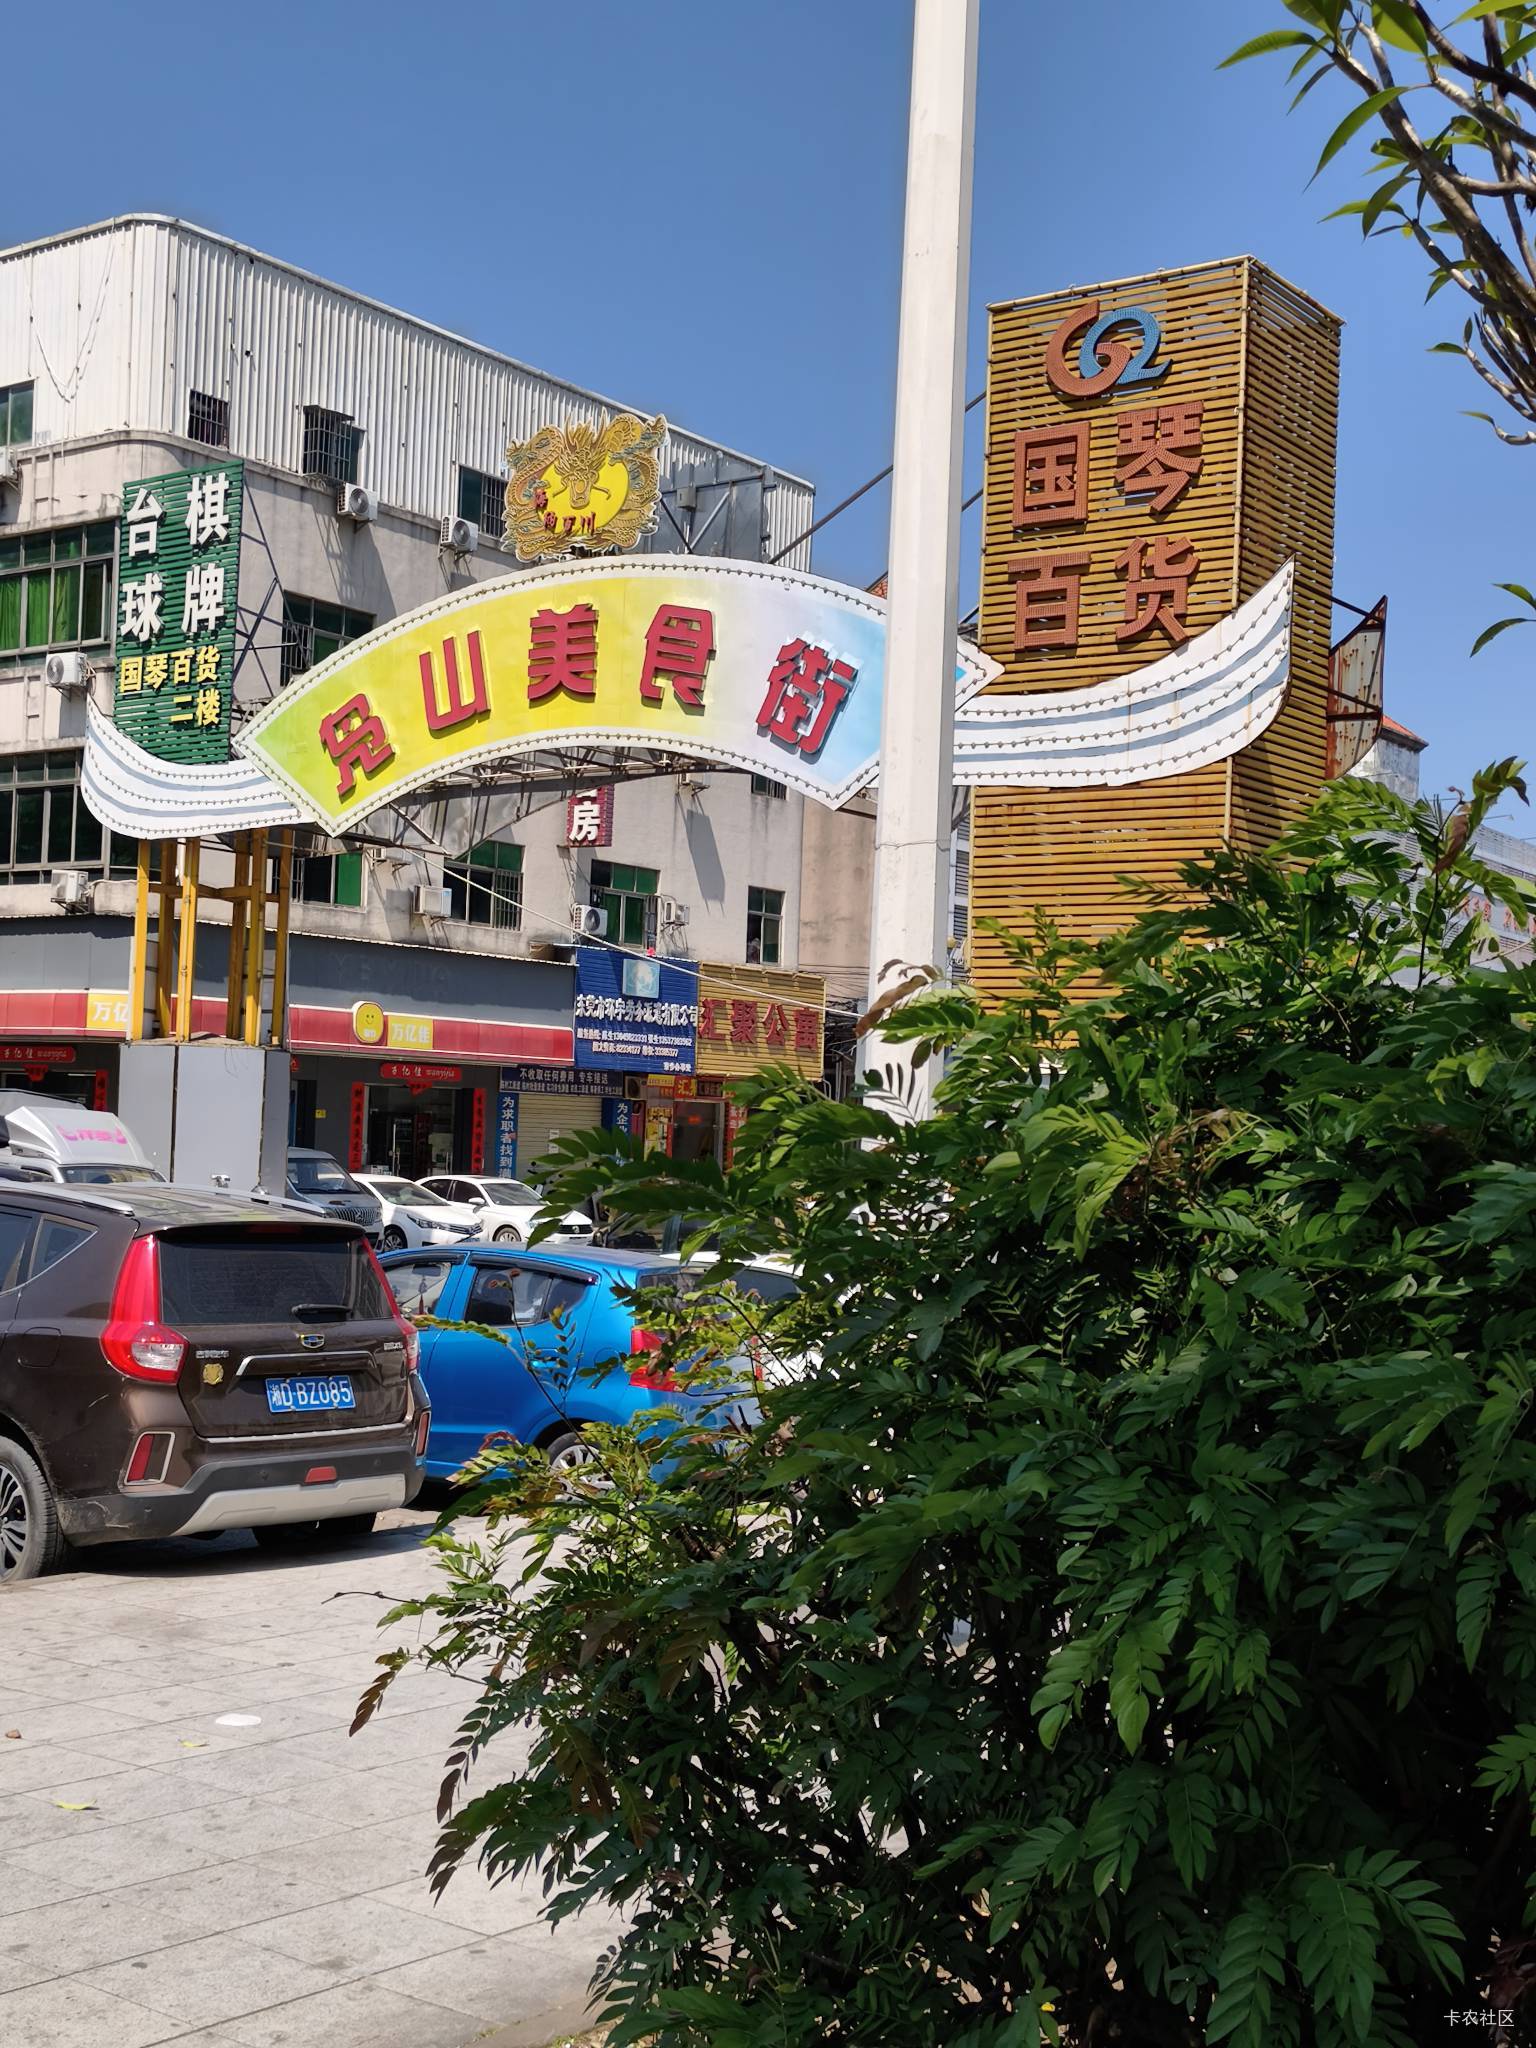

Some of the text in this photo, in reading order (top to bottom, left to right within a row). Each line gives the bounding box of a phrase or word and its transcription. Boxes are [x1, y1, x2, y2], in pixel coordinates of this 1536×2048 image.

[1012, 401, 1203, 528] 国琴
[120, 487, 164, 643] 台球
[181, 472, 230, 633] 棋牌
[1007, 535, 1200, 650] 百货
[119, 645, 221, 692] 国琴百货
[171, 688, 221, 726] 二楼
[319, 603, 857, 797] 凫山美食街
[569, 789, 601, 841] 房
[391, 1022, 431, 1044] 万亿佳
[698, 998, 819, 1051] 汇聚公寓
[519, 1068, 609, 1085] 不收取任何费用 专车接送
